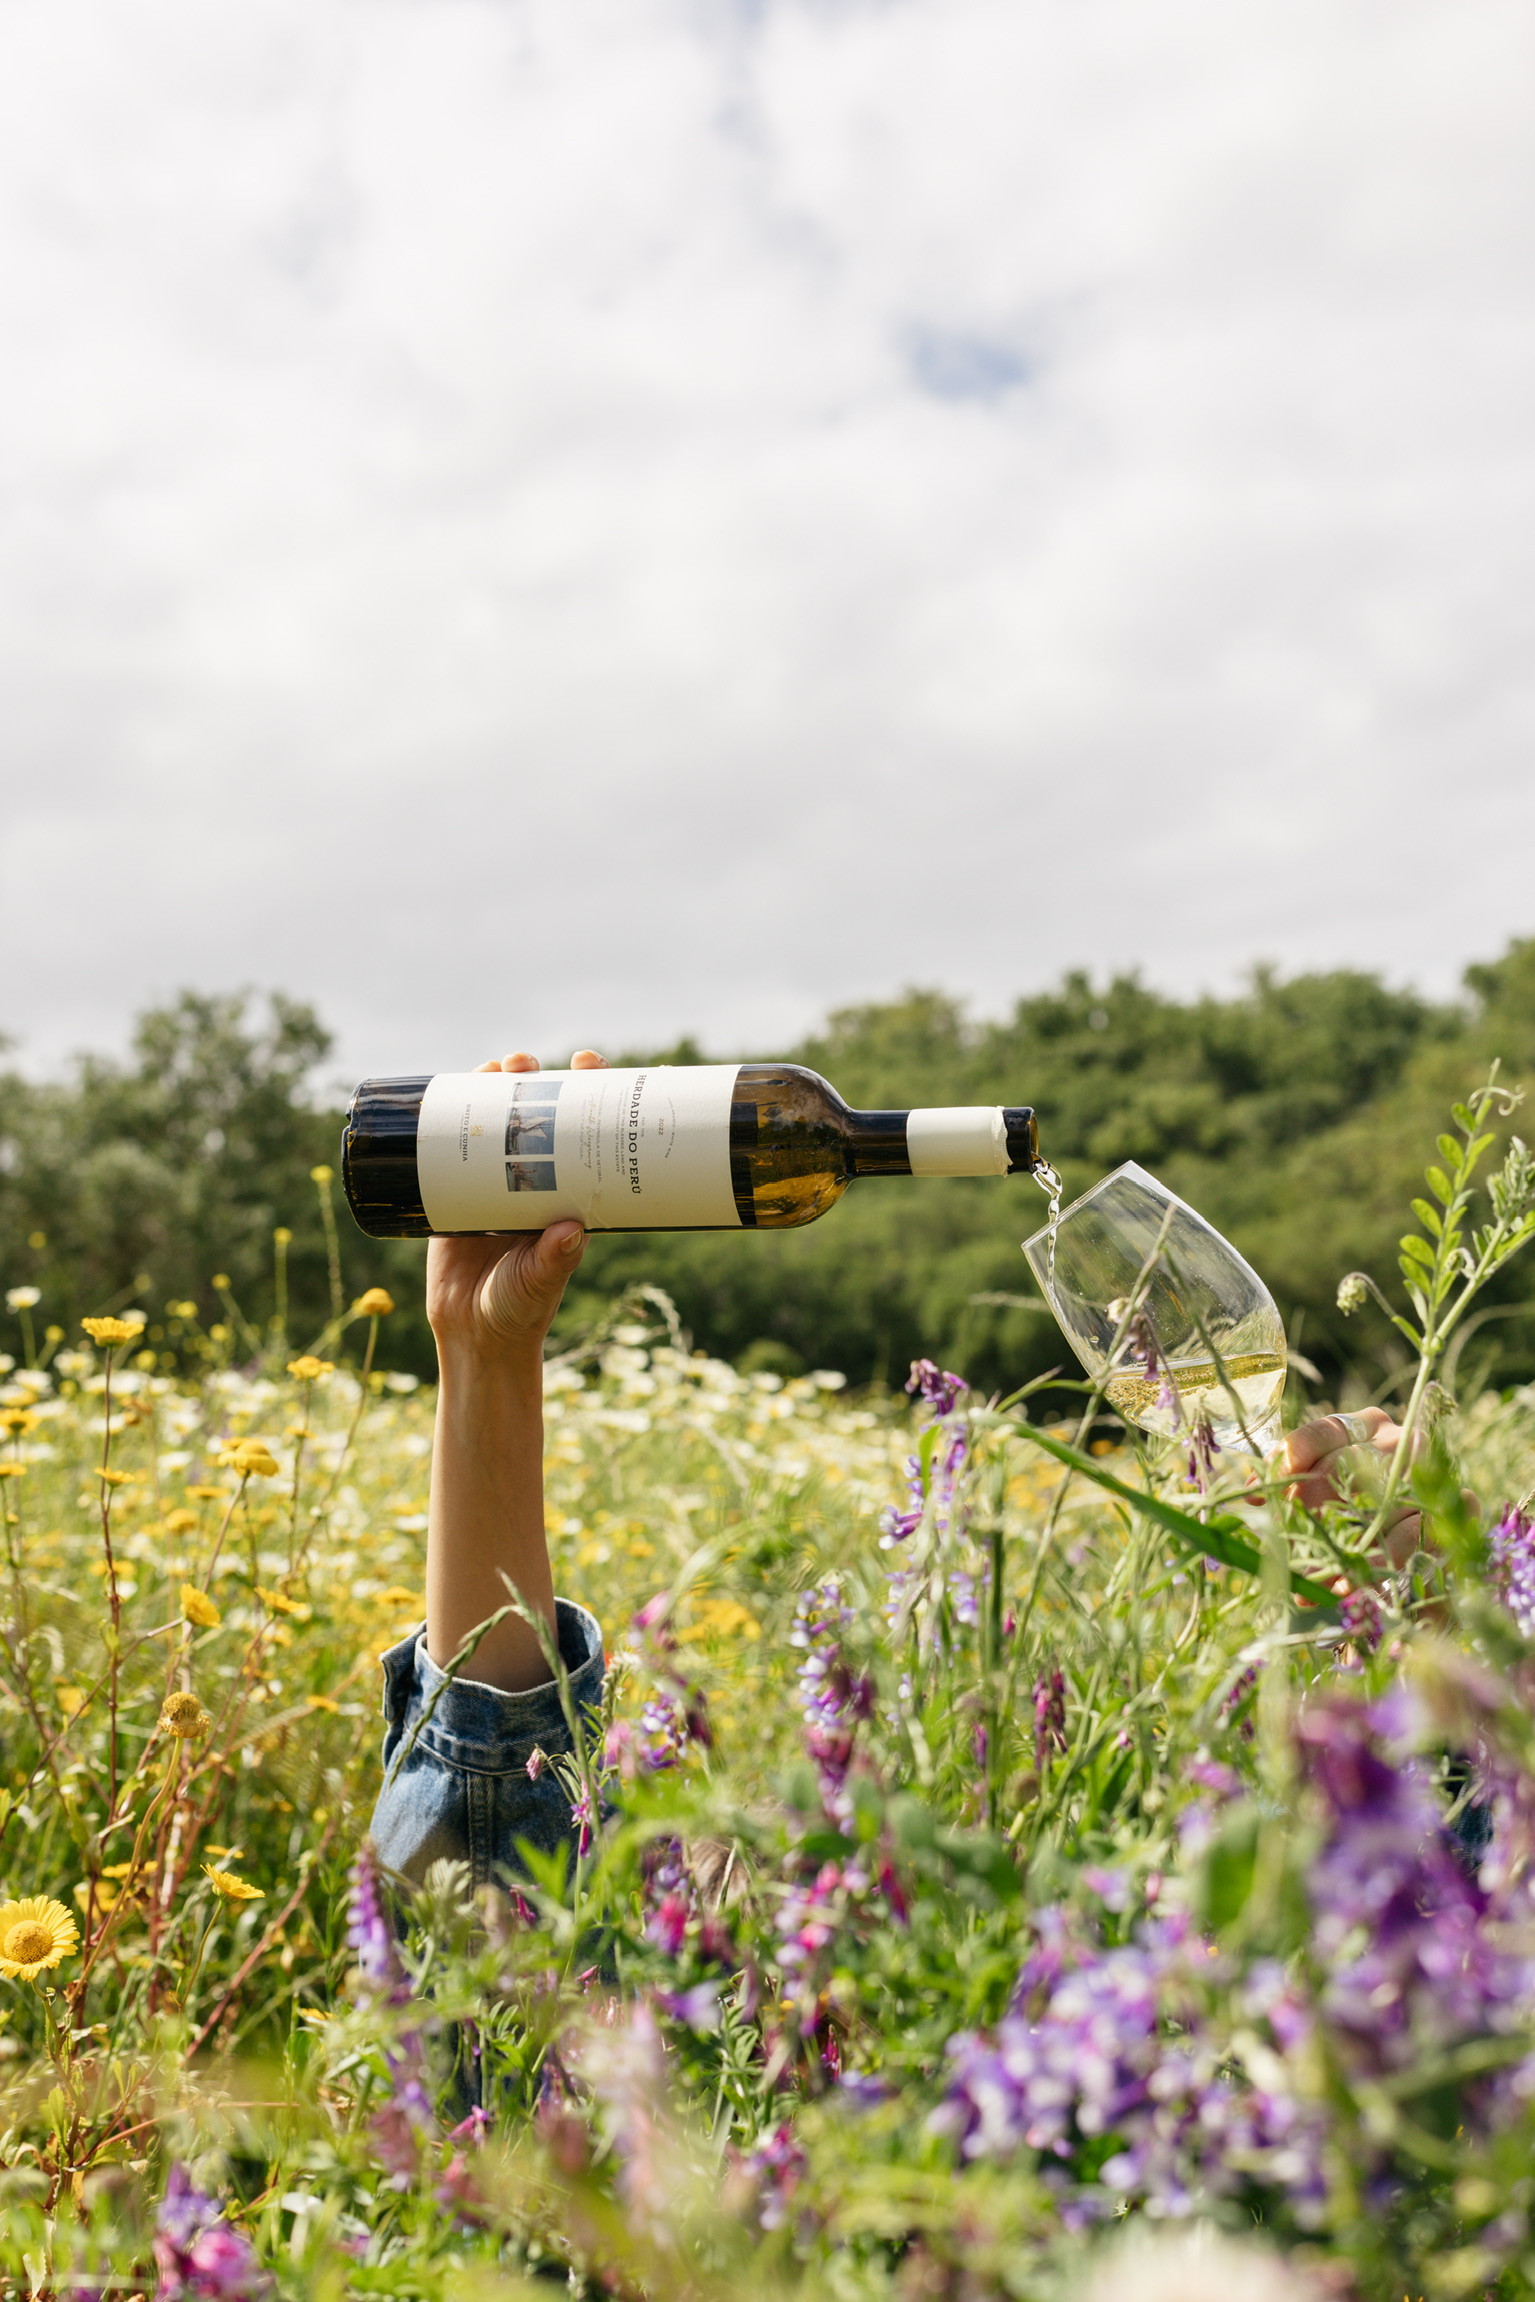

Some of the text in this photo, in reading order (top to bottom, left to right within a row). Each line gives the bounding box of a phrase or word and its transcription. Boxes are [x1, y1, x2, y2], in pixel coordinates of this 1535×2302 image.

[596, 1150, 601, 1158] DE
[629, 1074, 647, 1194] HERDADE DO PERÚ
